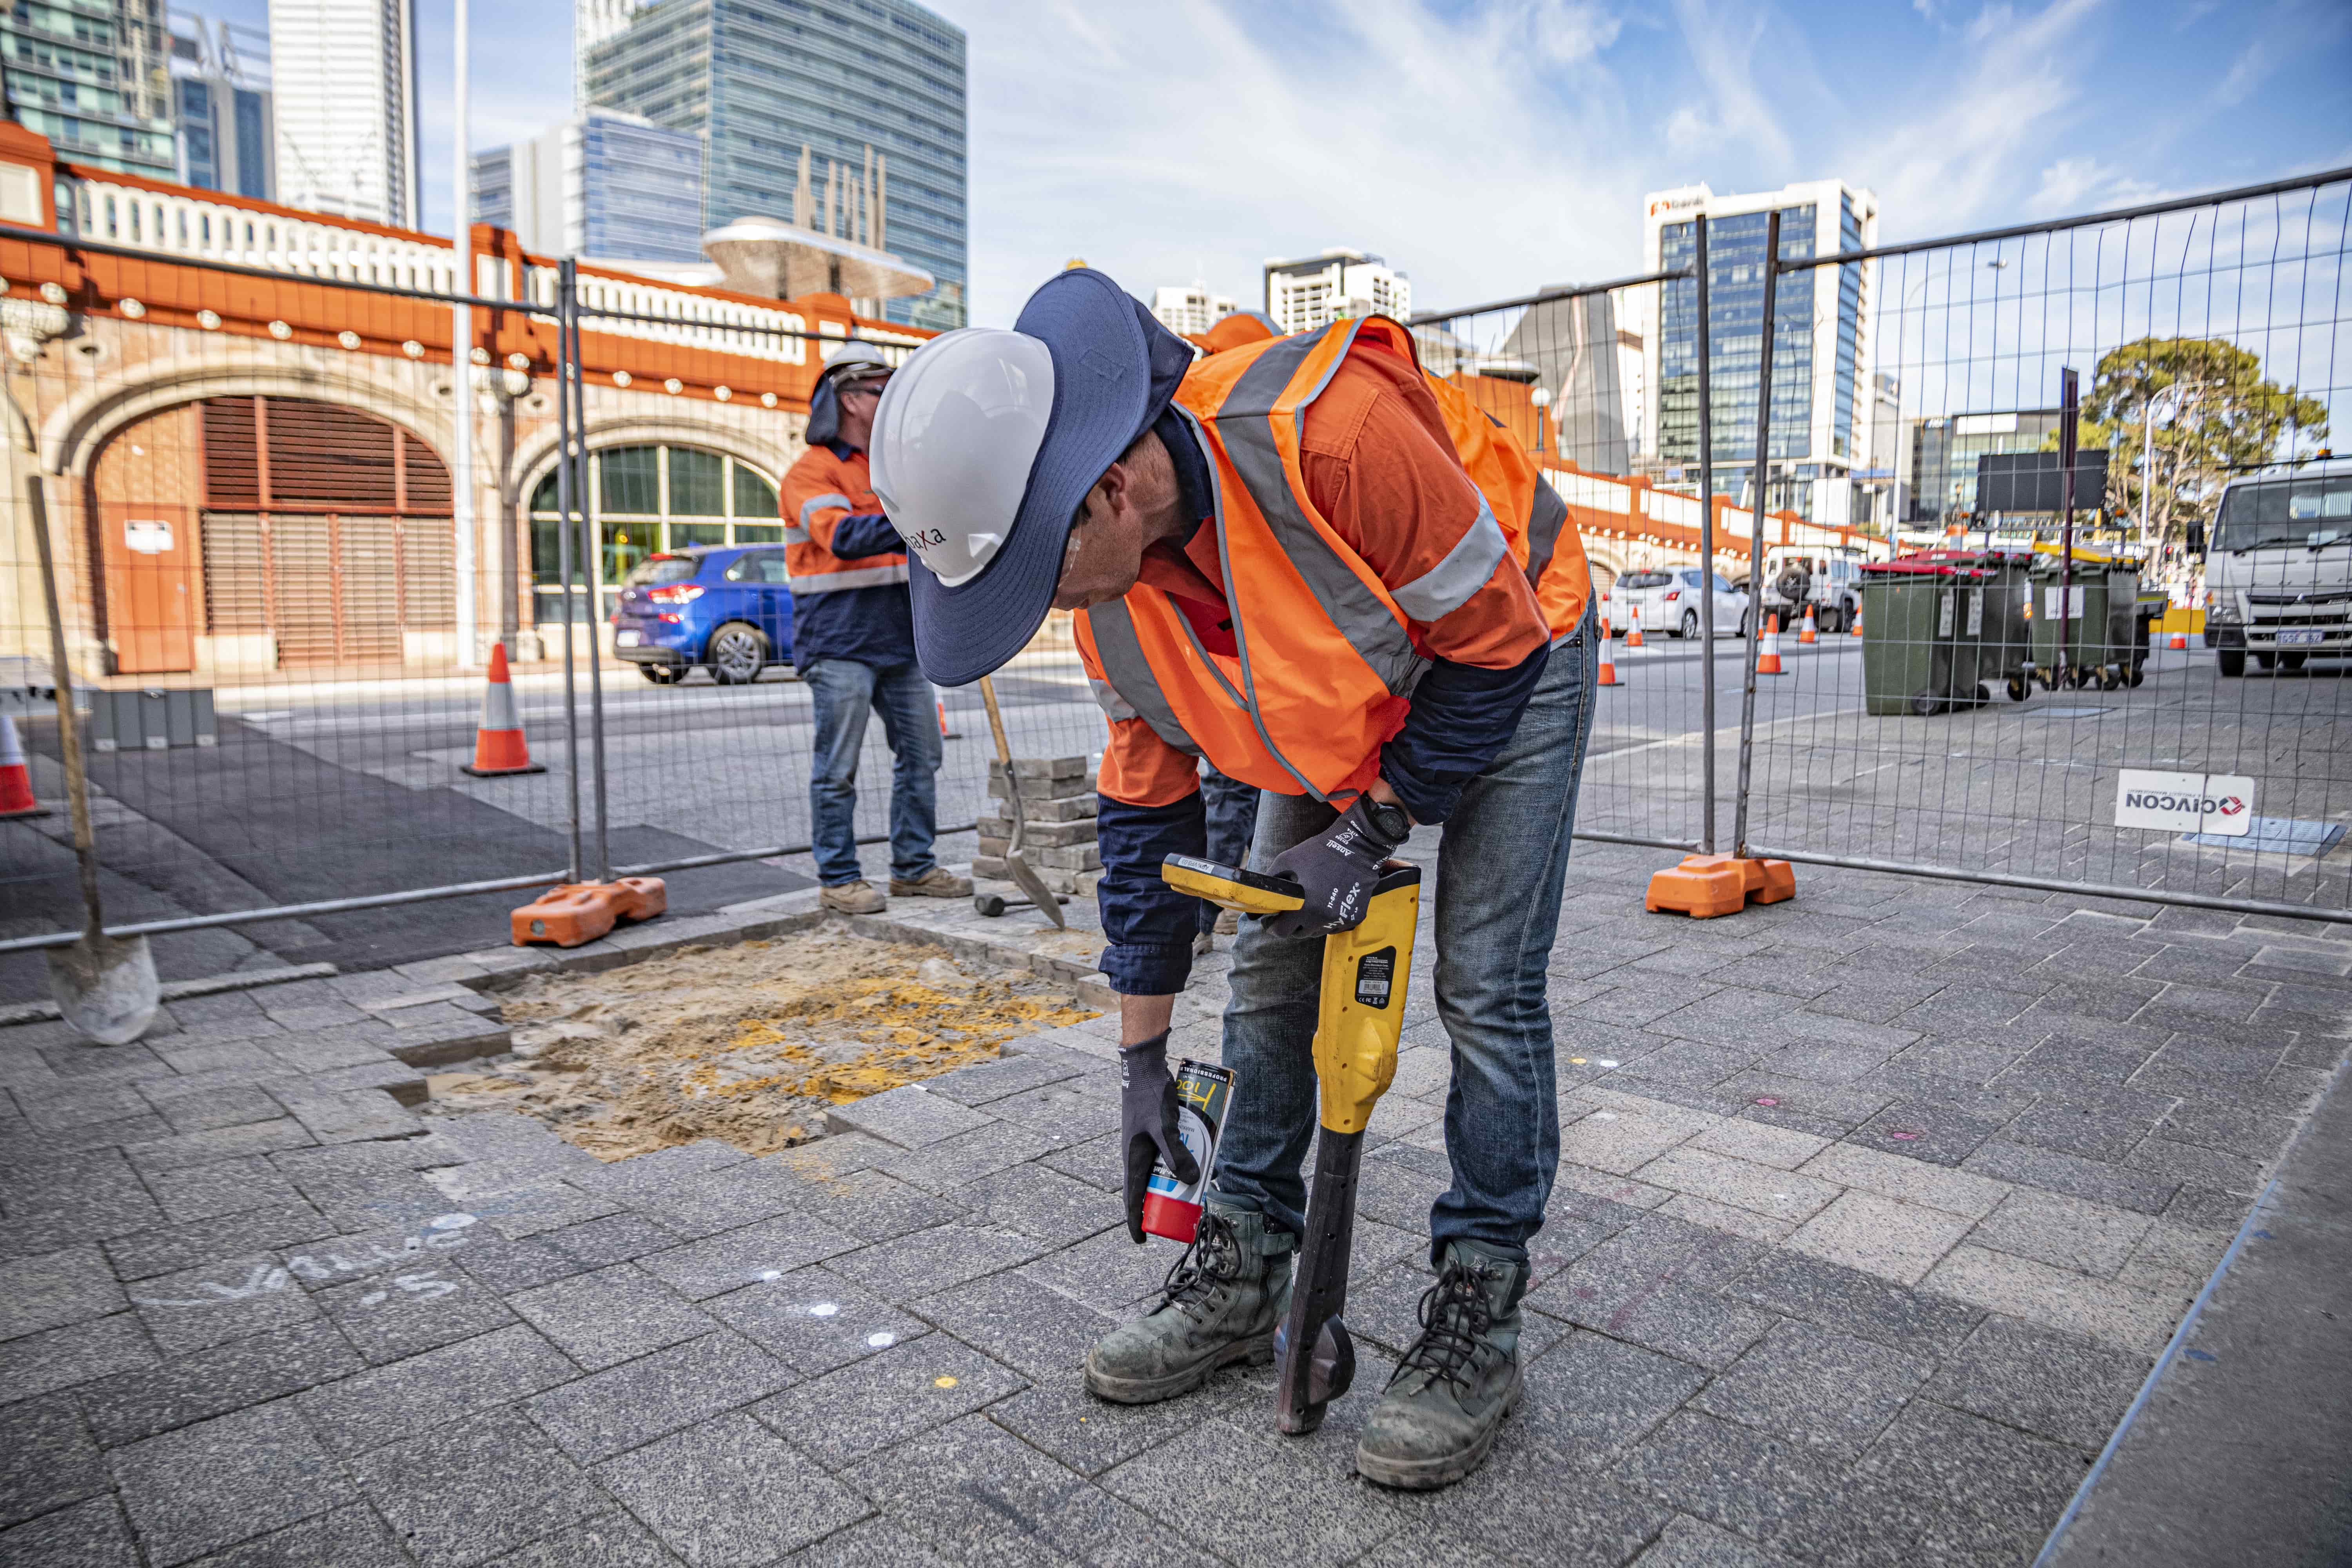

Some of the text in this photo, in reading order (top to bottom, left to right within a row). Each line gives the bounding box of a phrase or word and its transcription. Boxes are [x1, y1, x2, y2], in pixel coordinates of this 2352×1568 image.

[2126, 793, 2217, 814] CIVCON
[1326, 840, 1352, 857] Ansell
[1327, 887, 1338, 909] 11-840
[1184, 1067, 1227, 1082] PROFESSIONAL
[1179, 1124, 1195, 1132] MARKIN
